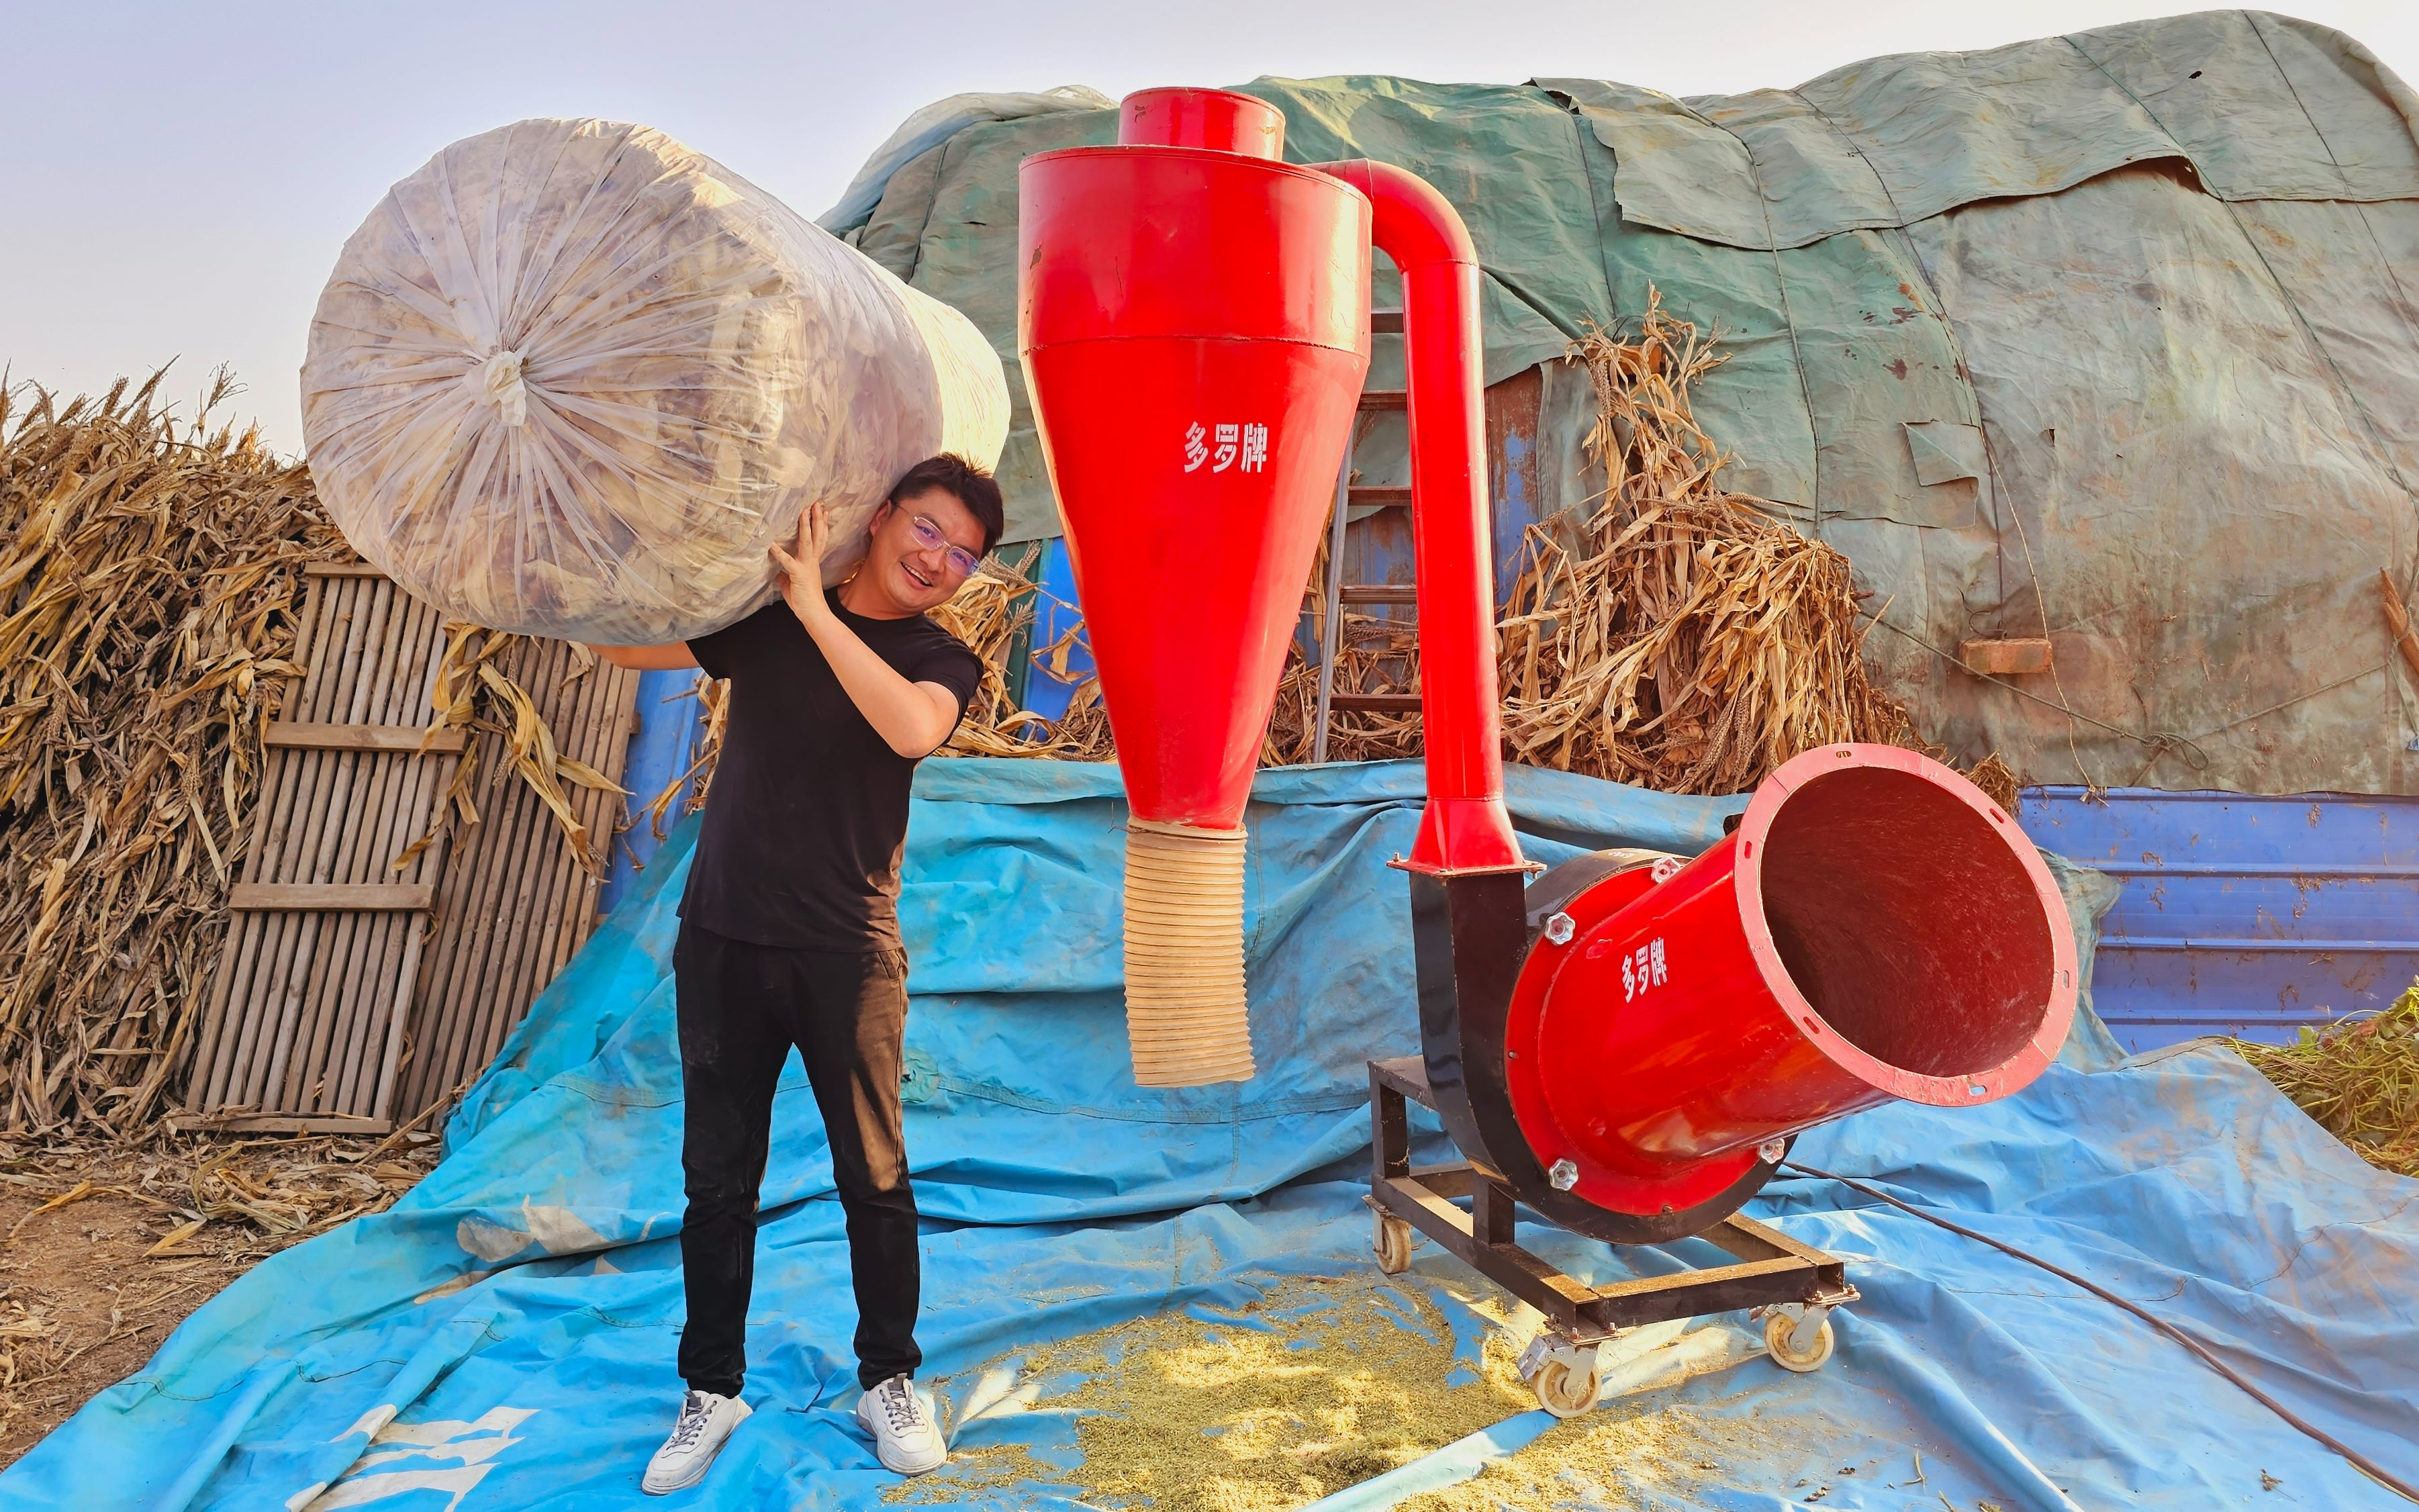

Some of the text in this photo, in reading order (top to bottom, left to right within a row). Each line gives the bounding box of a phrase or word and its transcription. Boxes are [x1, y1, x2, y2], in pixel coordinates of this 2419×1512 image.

[1184, 421, 1268, 473] 多罗牌
[1621, 937, 1668, 1003] 多罗牌
